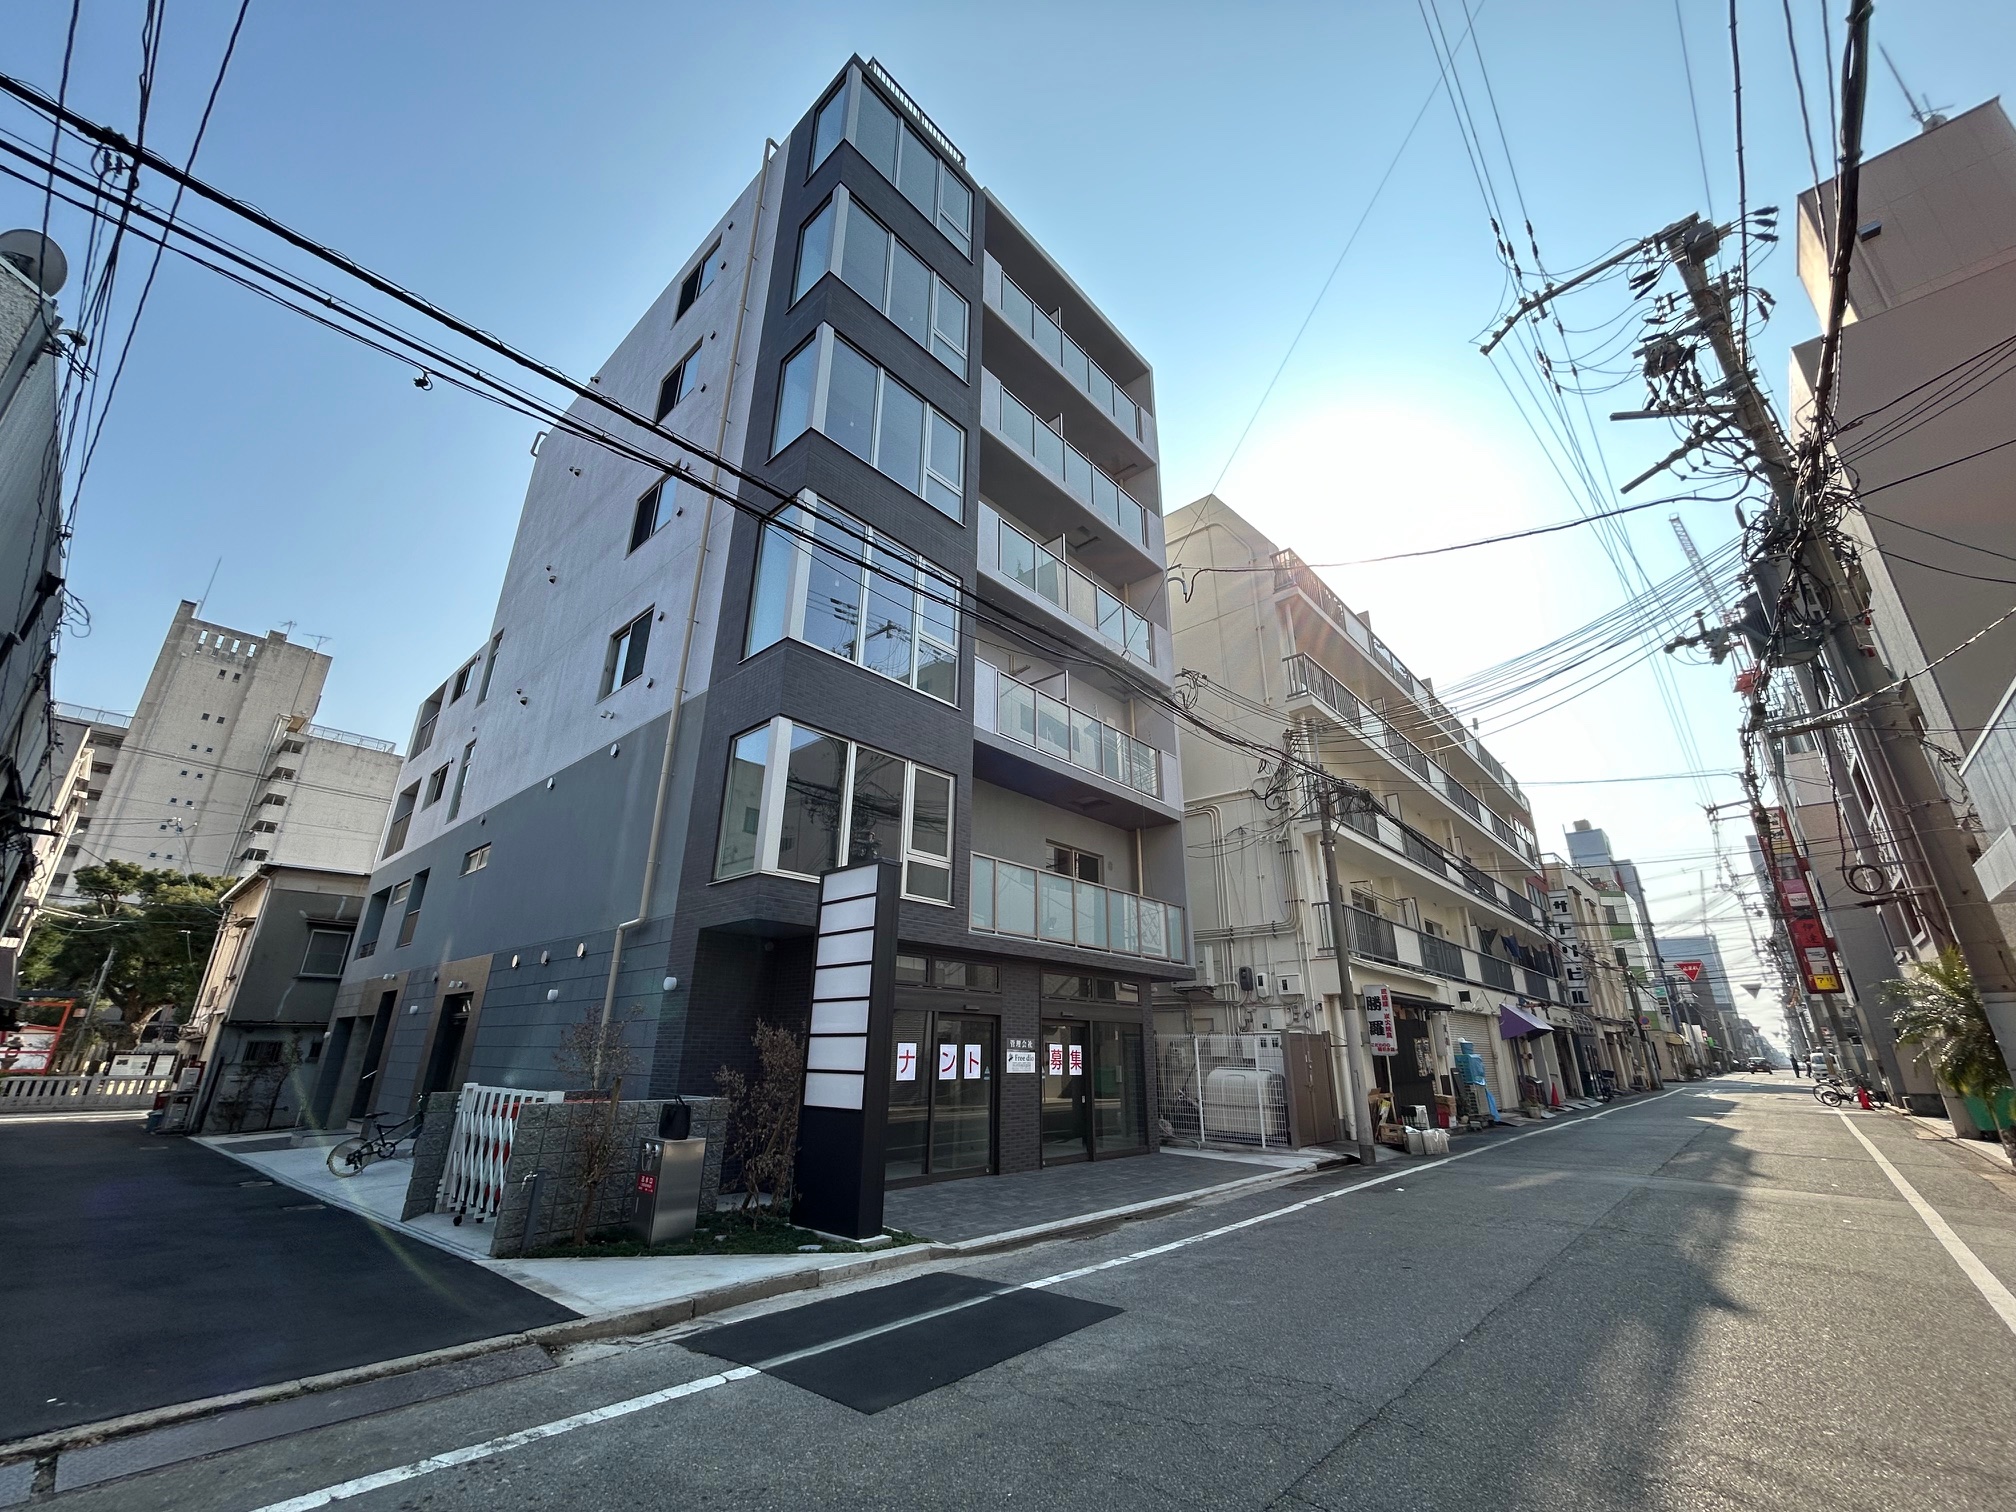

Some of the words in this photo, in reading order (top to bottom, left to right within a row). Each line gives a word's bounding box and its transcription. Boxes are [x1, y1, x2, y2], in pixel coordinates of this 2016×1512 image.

[1553, 900, 1589, 1004] サトリビル
[1009, 1039, 1034, 1049] 管理会社
[1050, 1049, 1082, 1071] 募集
